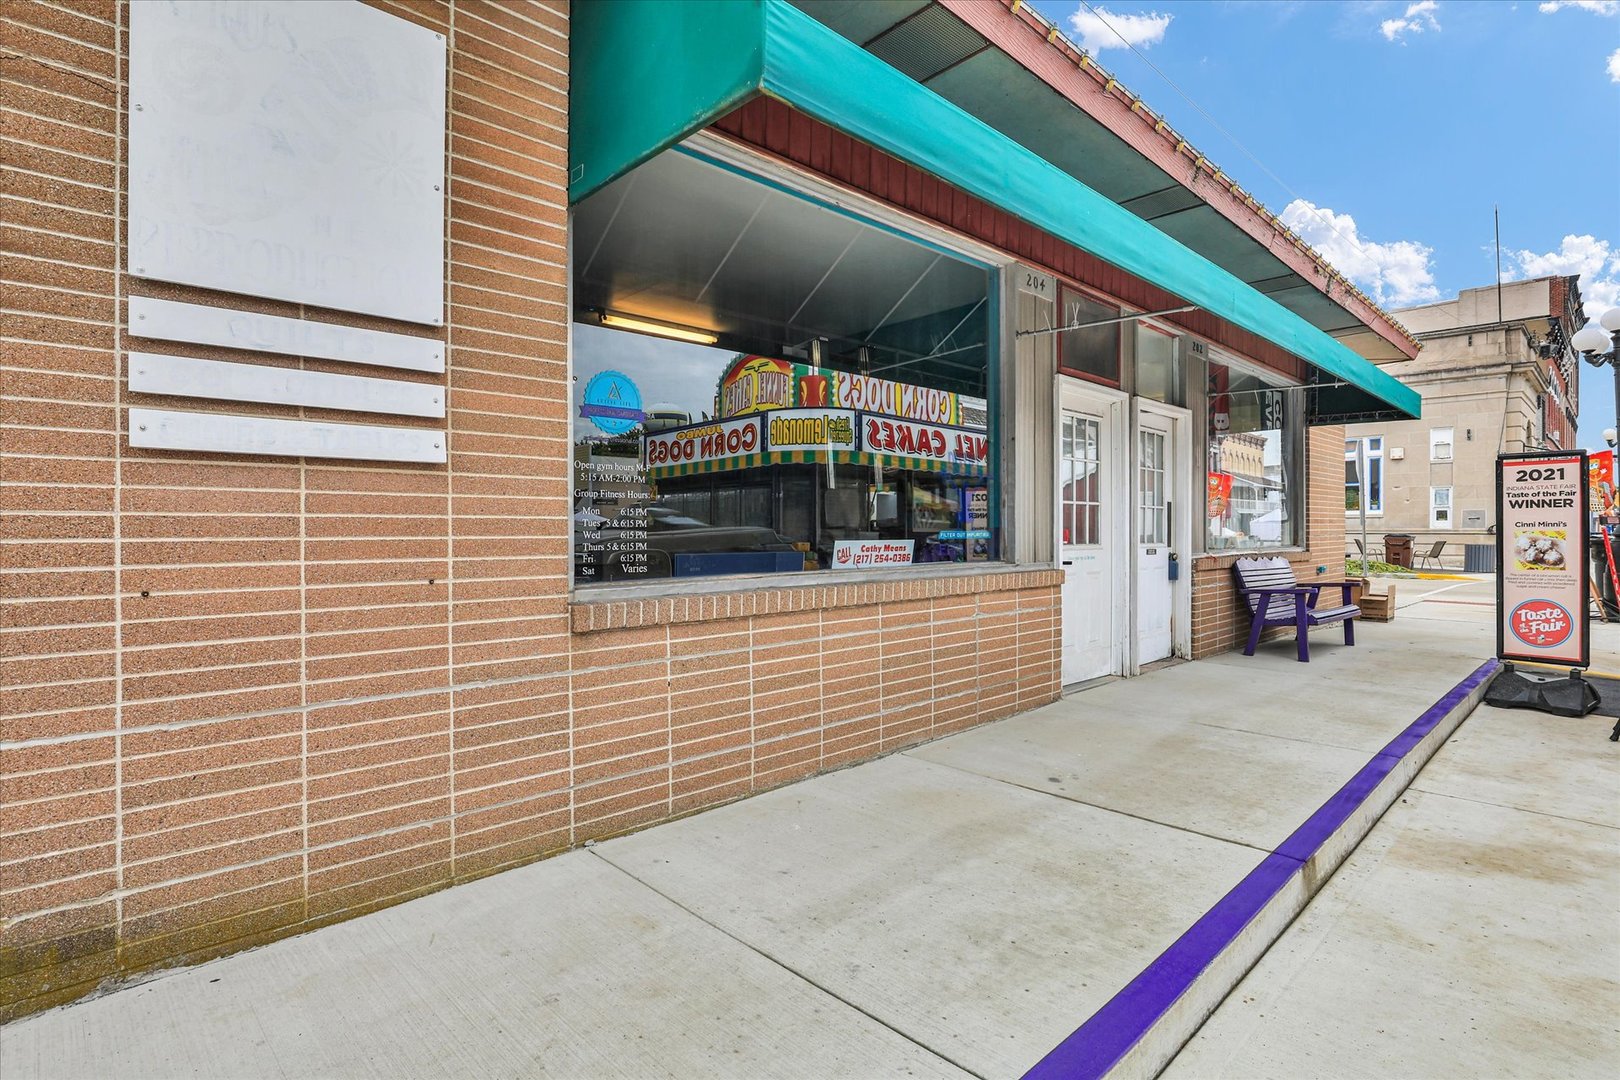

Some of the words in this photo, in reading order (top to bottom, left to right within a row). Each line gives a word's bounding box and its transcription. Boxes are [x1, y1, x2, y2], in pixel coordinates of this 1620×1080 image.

[1026, 273, 1046, 291] 204
[1192, 341, 1203, 354] 202
[574, 460, 594, 471] Open
[596, 463, 613, 471] gym
[614, 462, 634, 471] hours
[636, 464, 651, 472] M-F
[580, 473, 597, 481] 5:15
[598, 474, 631, 483] AM-2:00
[1516, 468, 1565, 482] 2021
[574, 488, 598, 499] Group
[600, 489, 625, 499] Fitness
[627, 490, 651, 499] Hours:
[1509, 498, 1574, 509] WINNER
[582, 507, 600, 515] Mon
[620, 508, 634, 516] 6:15
[635, 508, 647, 516] PM
[582, 519, 601, 527] Tues
[582, 531, 601, 539] Wed
[620, 531, 634, 539] 6:15
[635, 531, 647, 539] PM
[582, 543, 605, 551] Thurs
[606, 543, 611, 551] 5
[860, 544, 881, 553] Cathy
[883, 544, 907, 552] Means
[620, 554, 634, 562] 6:15
[836, 546, 852, 561] CALL
[853, 554, 872, 564] (217)
[874, 553, 911, 562] 254-0386
[582, 567, 595, 575] Sat
[622, 564, 648, 573] Varies
[1517, 608, 1564, 621] Taste
[1528, 619, 1566, 634] Fair
